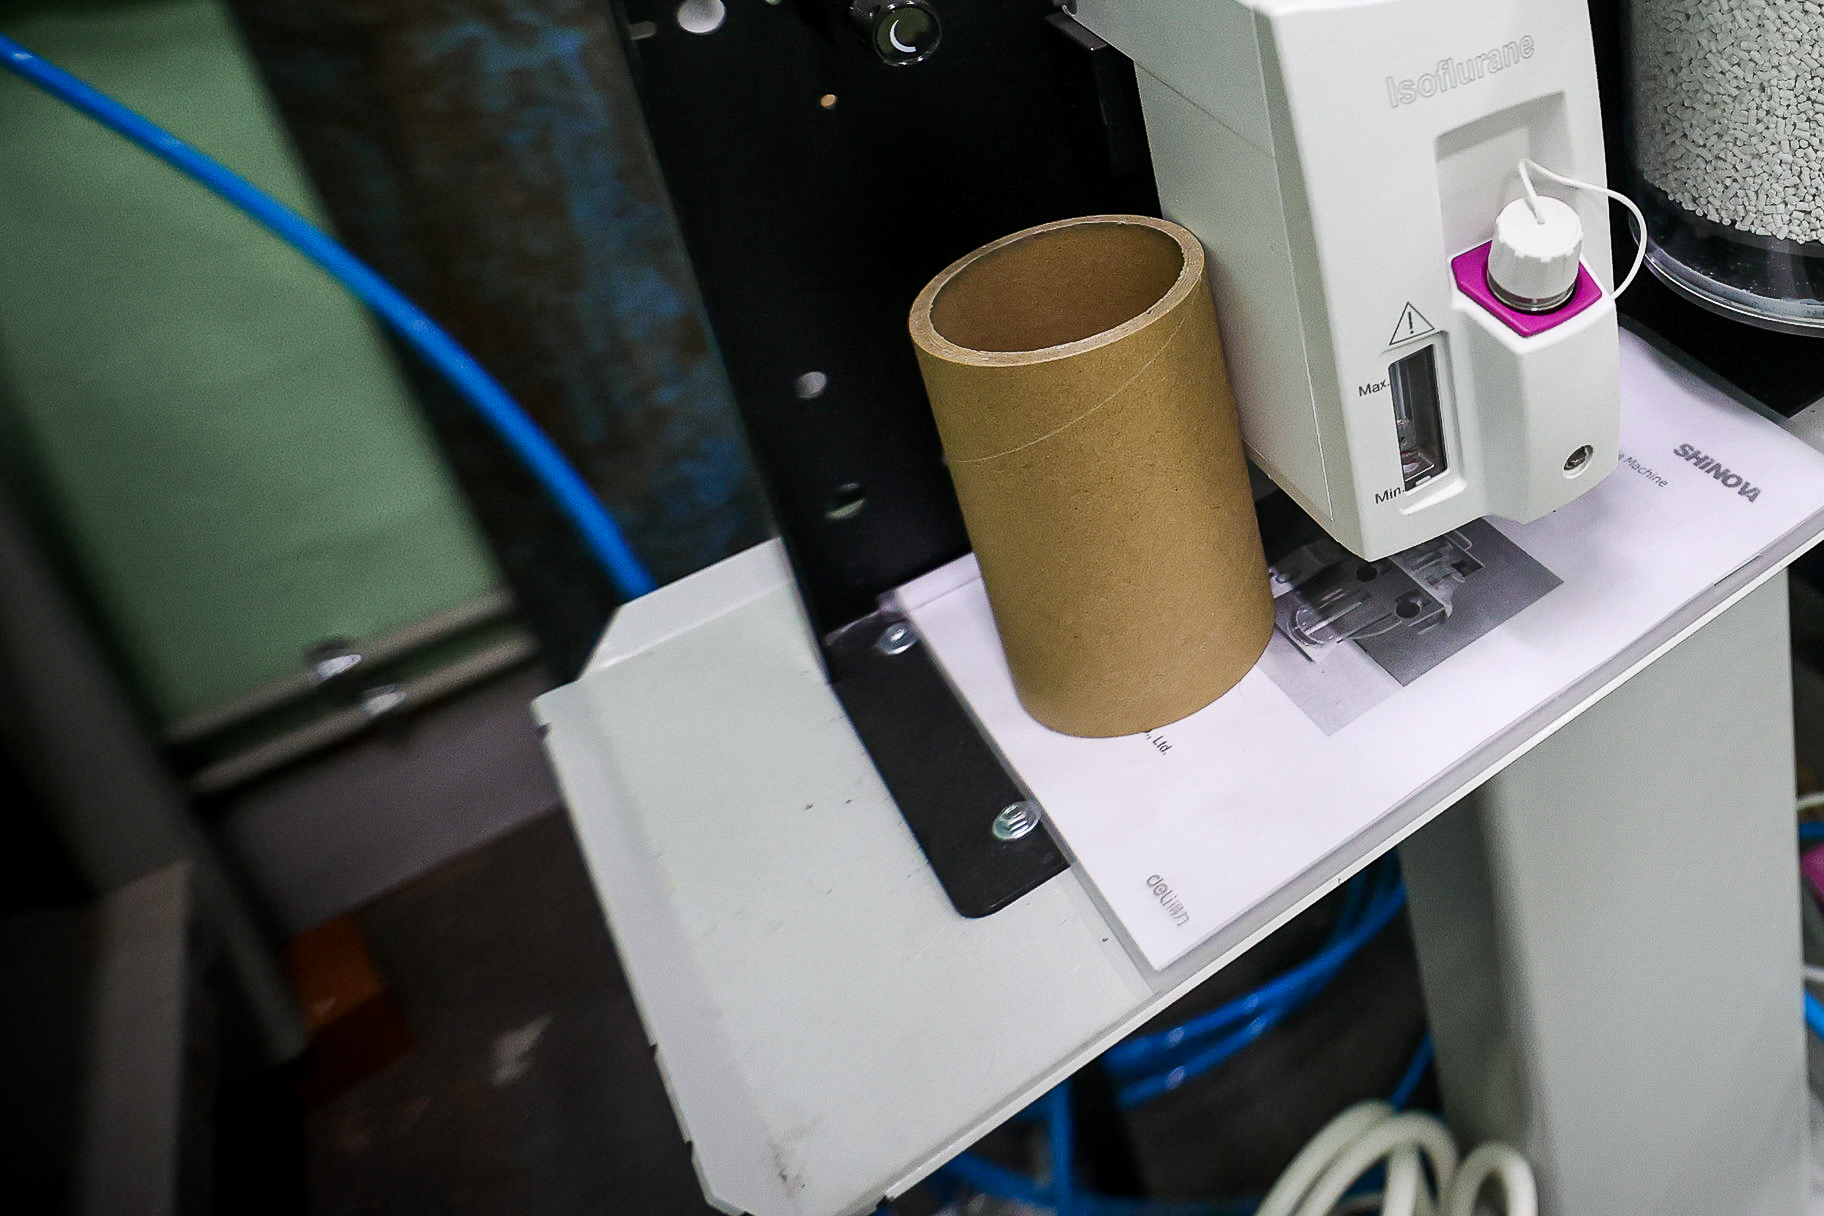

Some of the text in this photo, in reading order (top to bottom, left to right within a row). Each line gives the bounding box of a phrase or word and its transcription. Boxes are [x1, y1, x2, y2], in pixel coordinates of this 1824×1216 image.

[1385, 34, 1535, 109] Isoflurane
[1624, 456, 1669, 488] Machine
[1673, 443, 1761, 503] SHINOVA
